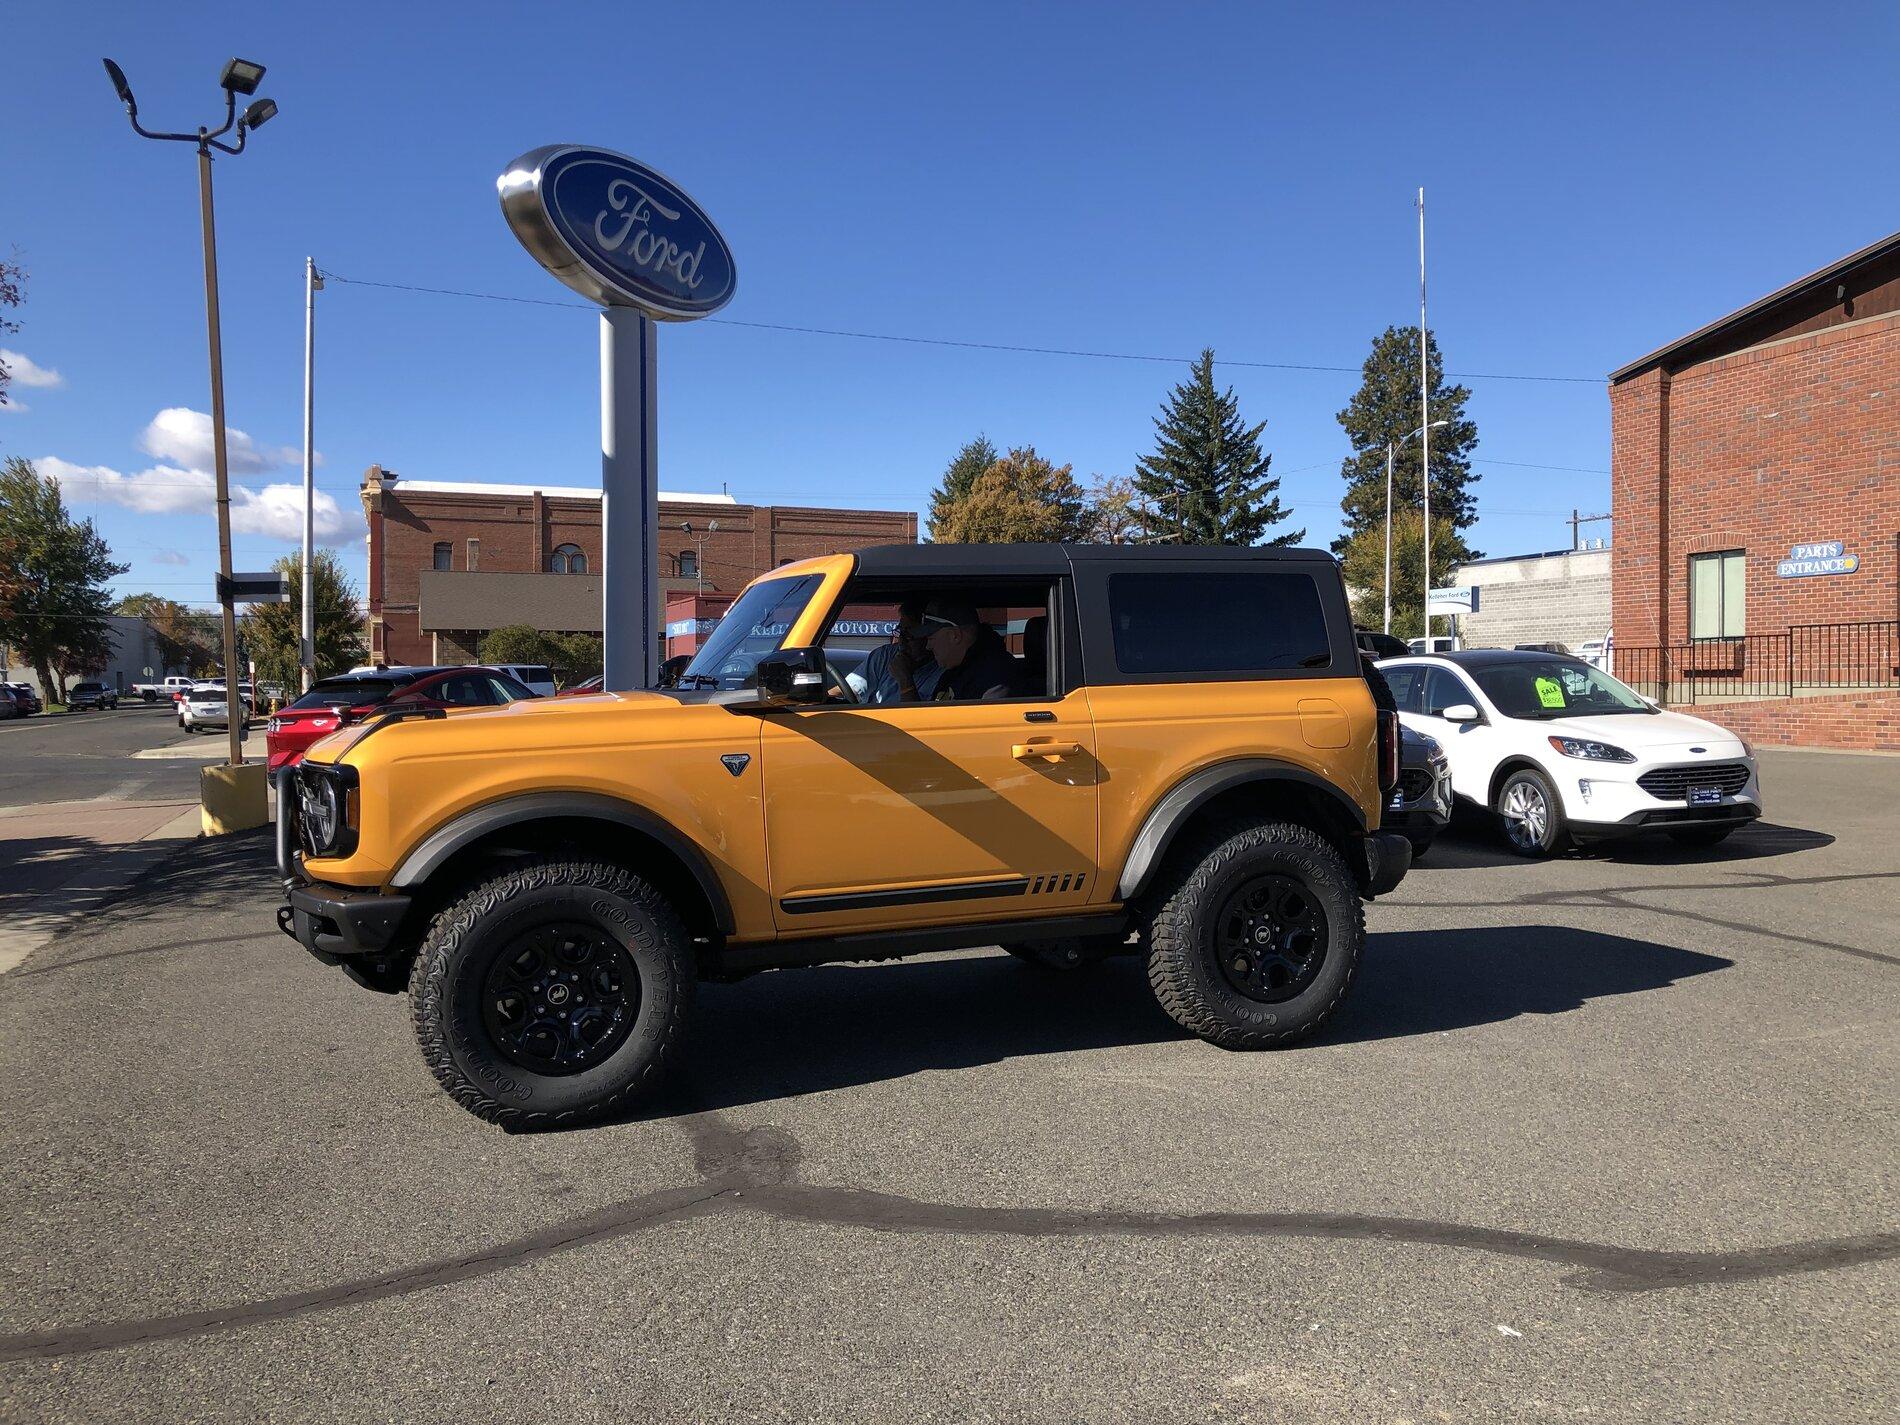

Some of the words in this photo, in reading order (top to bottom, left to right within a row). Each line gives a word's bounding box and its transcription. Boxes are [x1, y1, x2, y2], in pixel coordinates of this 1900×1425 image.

[594, 178, 706, 290] Ford
[1796, 543, 1838, 558] PARTS
[1780, 559, 1845, 575] ENTRANCE
[751, 624, 789, 635] KELL
[1541, 686, 1559, 695] SALE
[591, 900, 670, 1042] GOODYEAR
